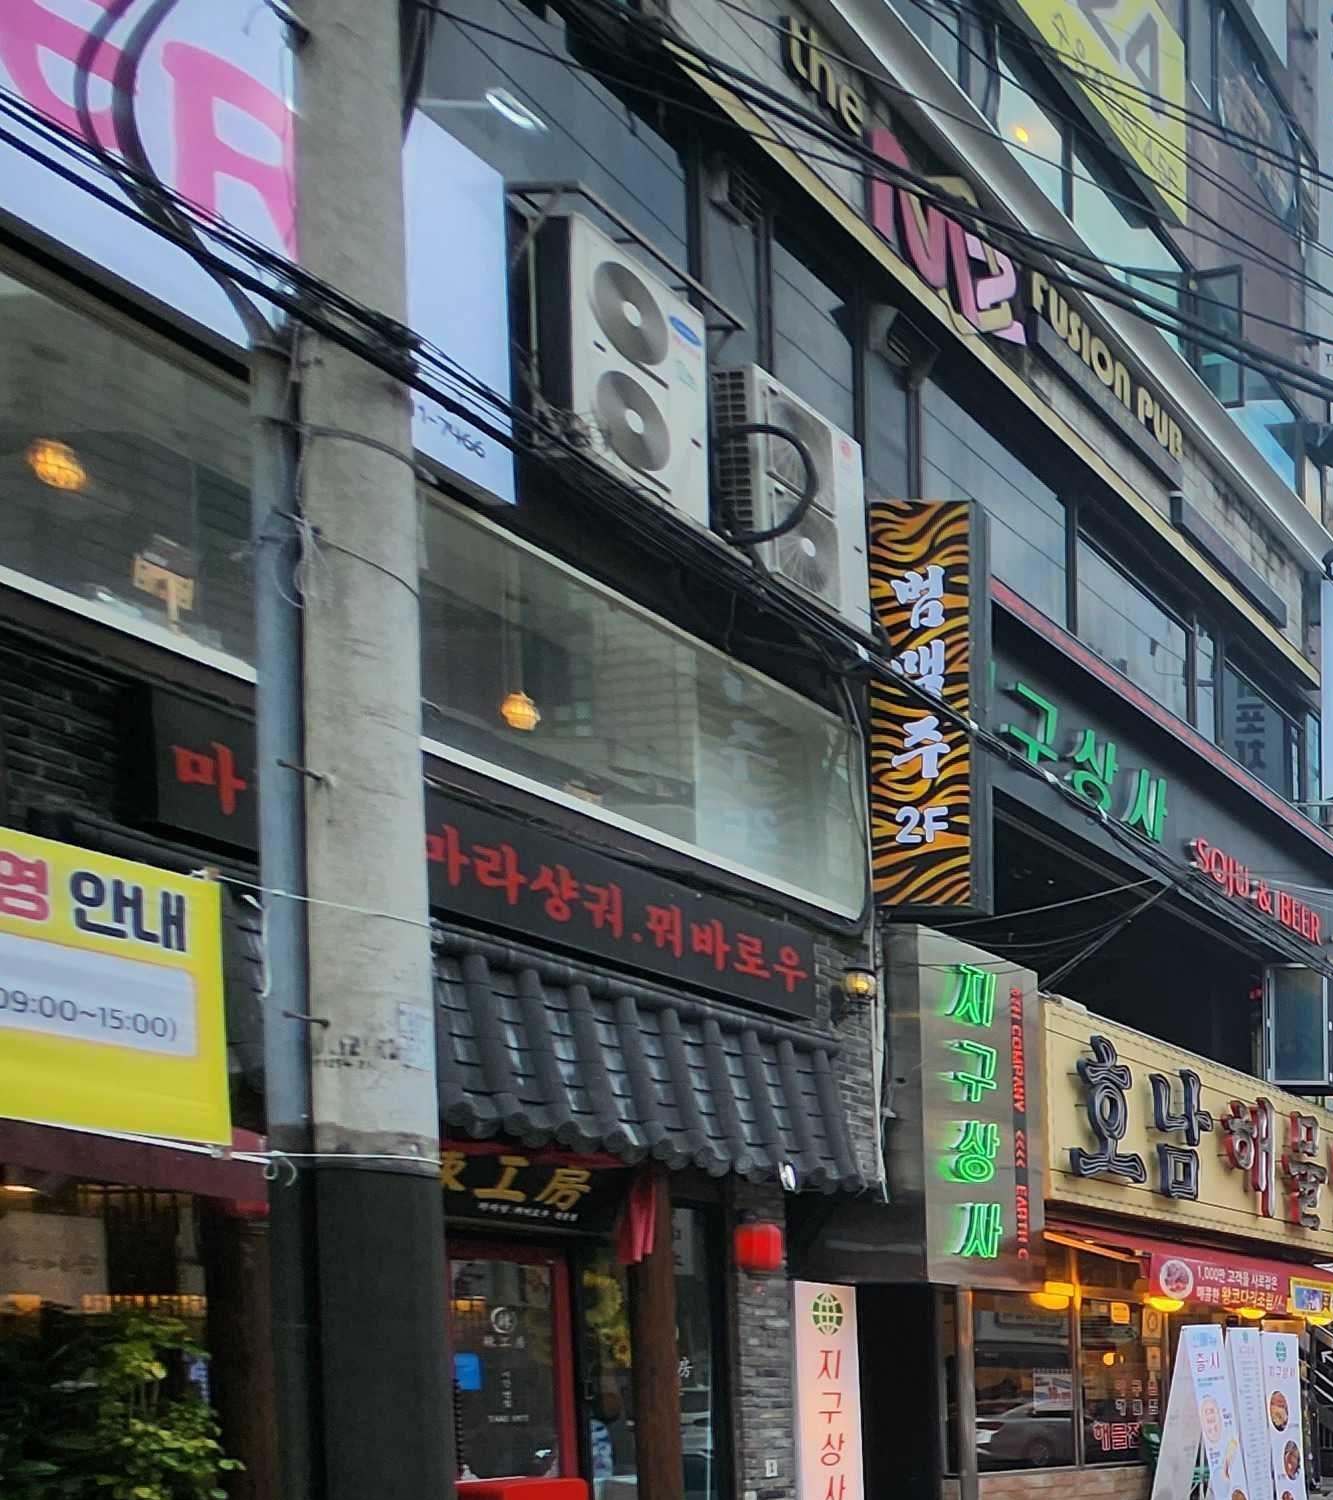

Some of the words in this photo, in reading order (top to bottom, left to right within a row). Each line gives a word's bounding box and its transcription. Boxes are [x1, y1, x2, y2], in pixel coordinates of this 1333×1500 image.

[1031, 271, 1132, 407] FUSION
[1138, 387, 1184, 463] PUB
[891, 564, 946, 779] 범맥주
[989, 661, 1168, 843] 구상사
[895, 804, 948, 844] 2F
[1191, 837, 1251, 900] SOJU
[1275, 889, 1323, 946] BEER
[70, 870, 188, 953] 안내
[949, 962, 1004, 1259] 지구상사
[1070, 1035, 1213, 1201] 호남
